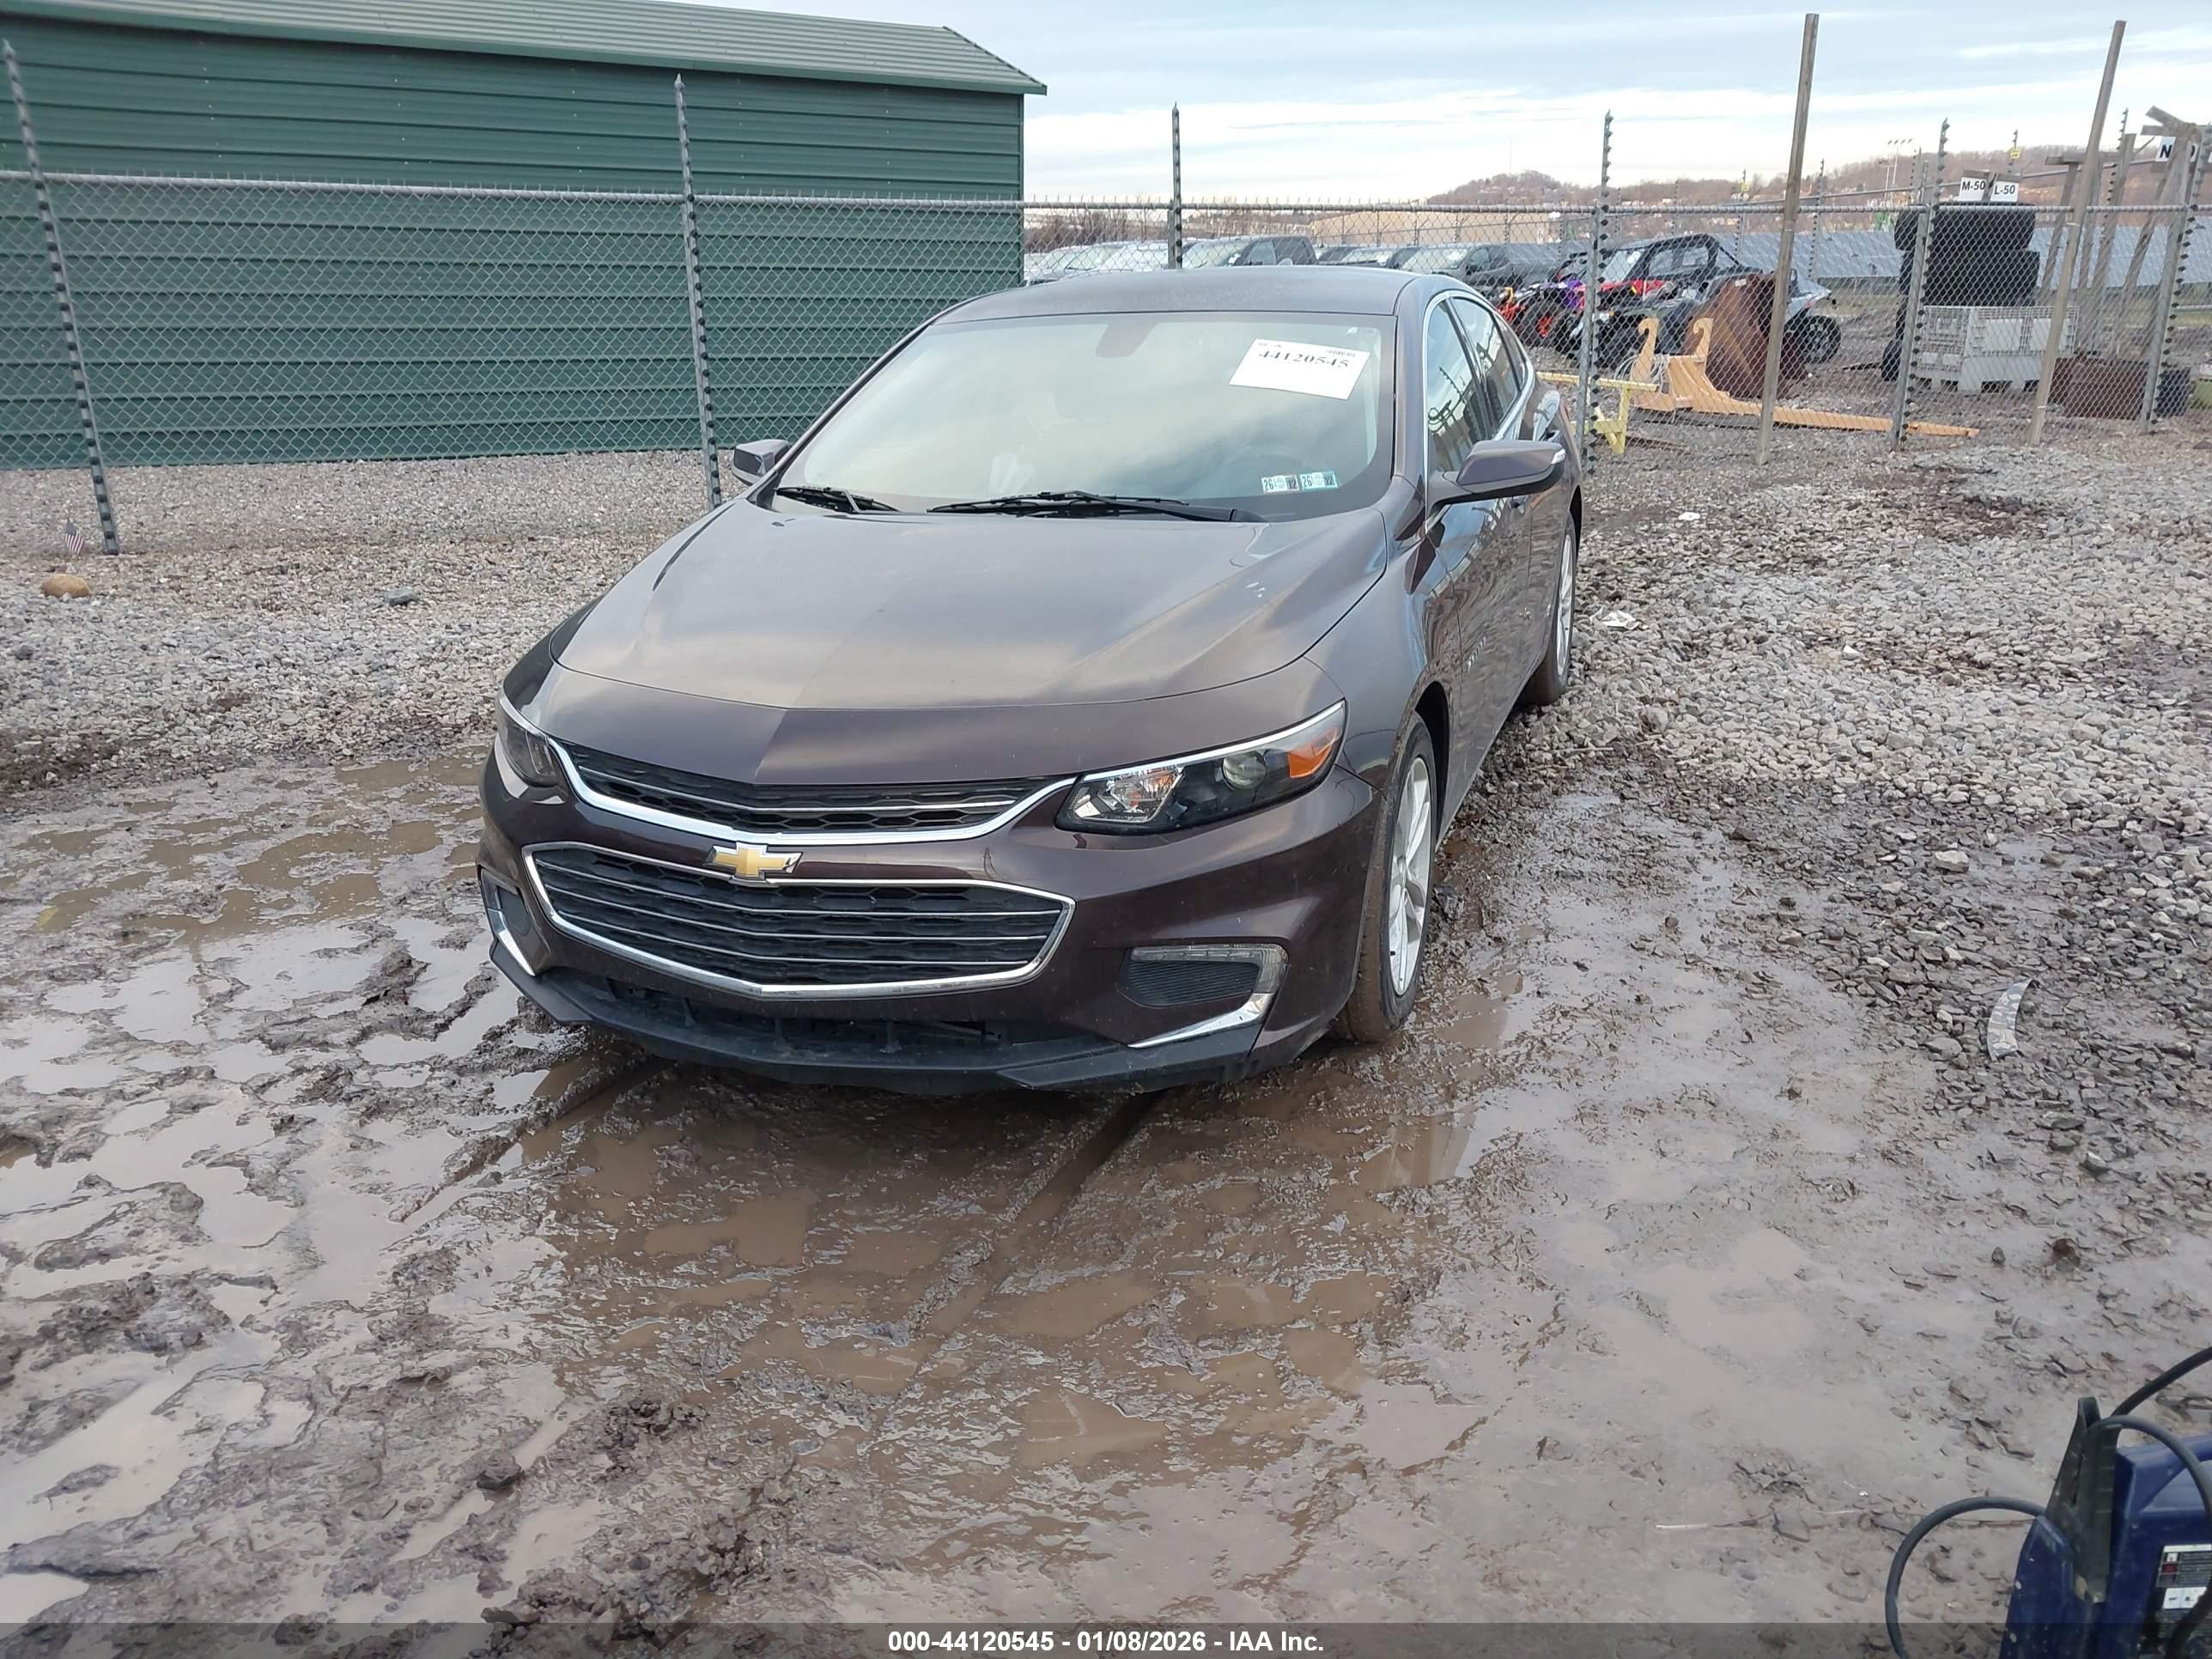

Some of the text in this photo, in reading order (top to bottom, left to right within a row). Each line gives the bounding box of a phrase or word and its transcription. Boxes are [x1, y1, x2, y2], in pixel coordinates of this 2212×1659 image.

[1961, 180, 1986, 191] M-50
[1994, 185, 2016, 195] L-50
[1258, 349, 1351, 368] 44120545
[1263, 478, 1274, 491] 26
[1301, 475, 1313, 488] 26
